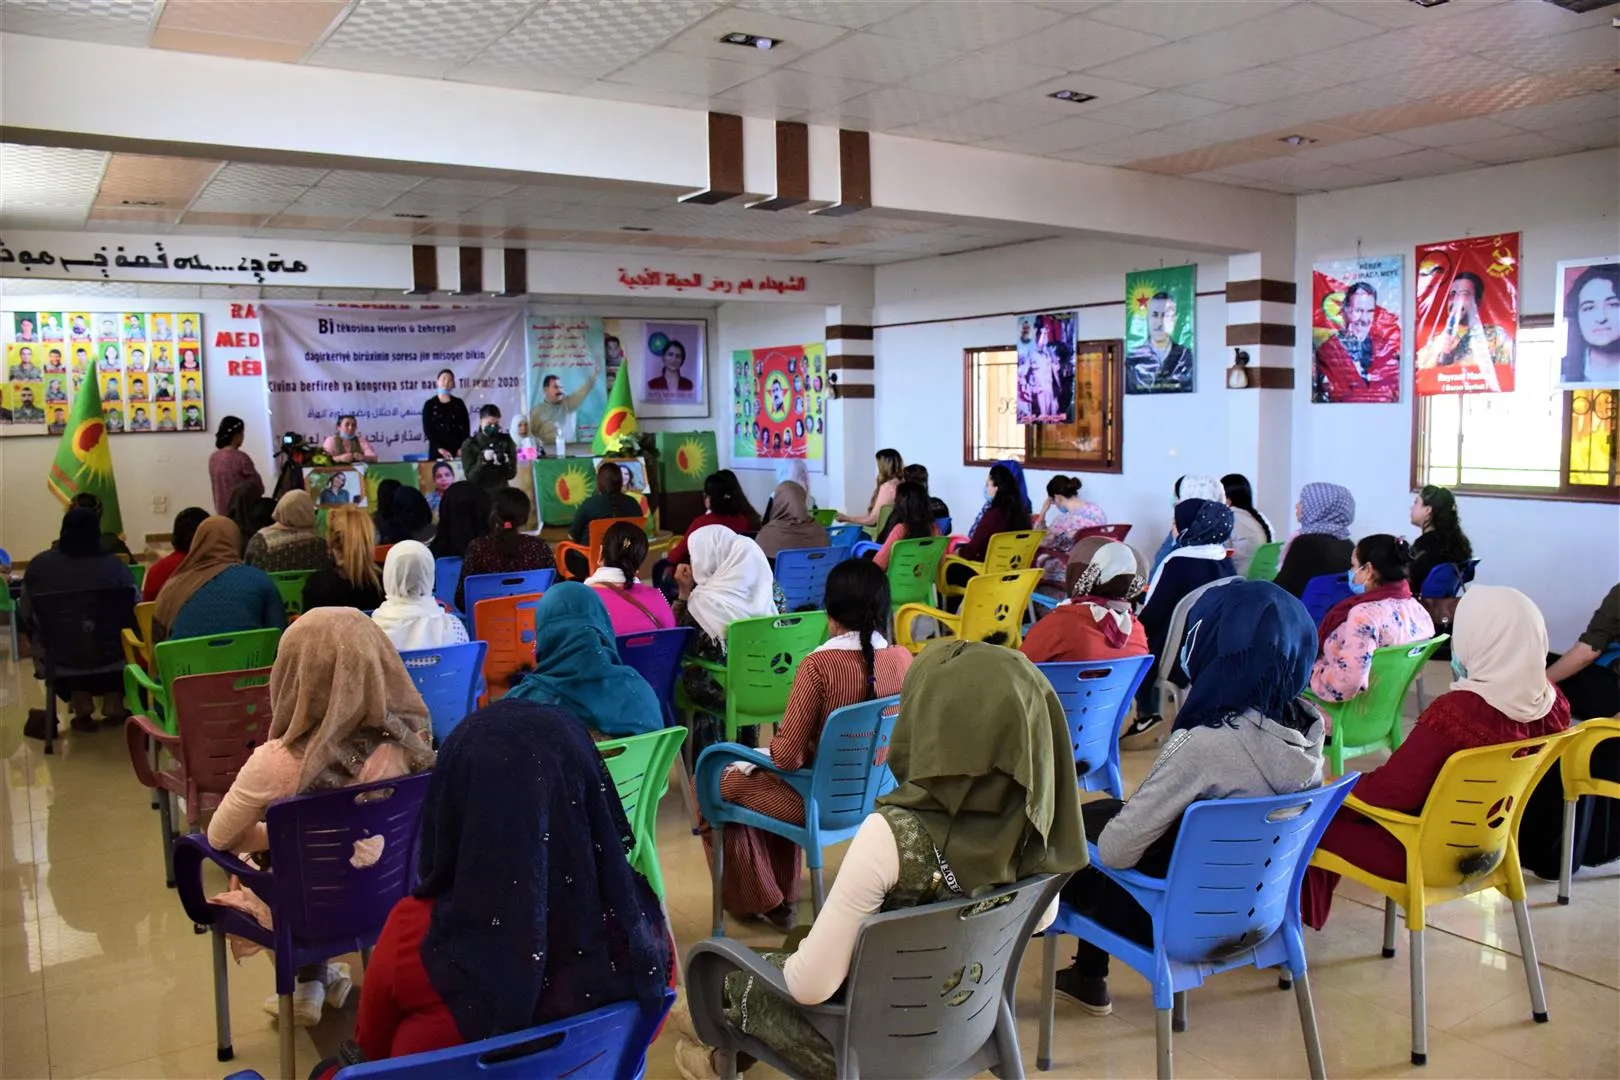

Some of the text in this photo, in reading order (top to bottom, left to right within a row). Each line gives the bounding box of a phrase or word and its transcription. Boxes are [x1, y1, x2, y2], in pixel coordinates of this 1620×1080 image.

[738, 278, 754, 294] هم
[758, 275, 806, 294] الشهداء
[400, 380, 418, 391] star
[498, 376, 520, 388] 2020
